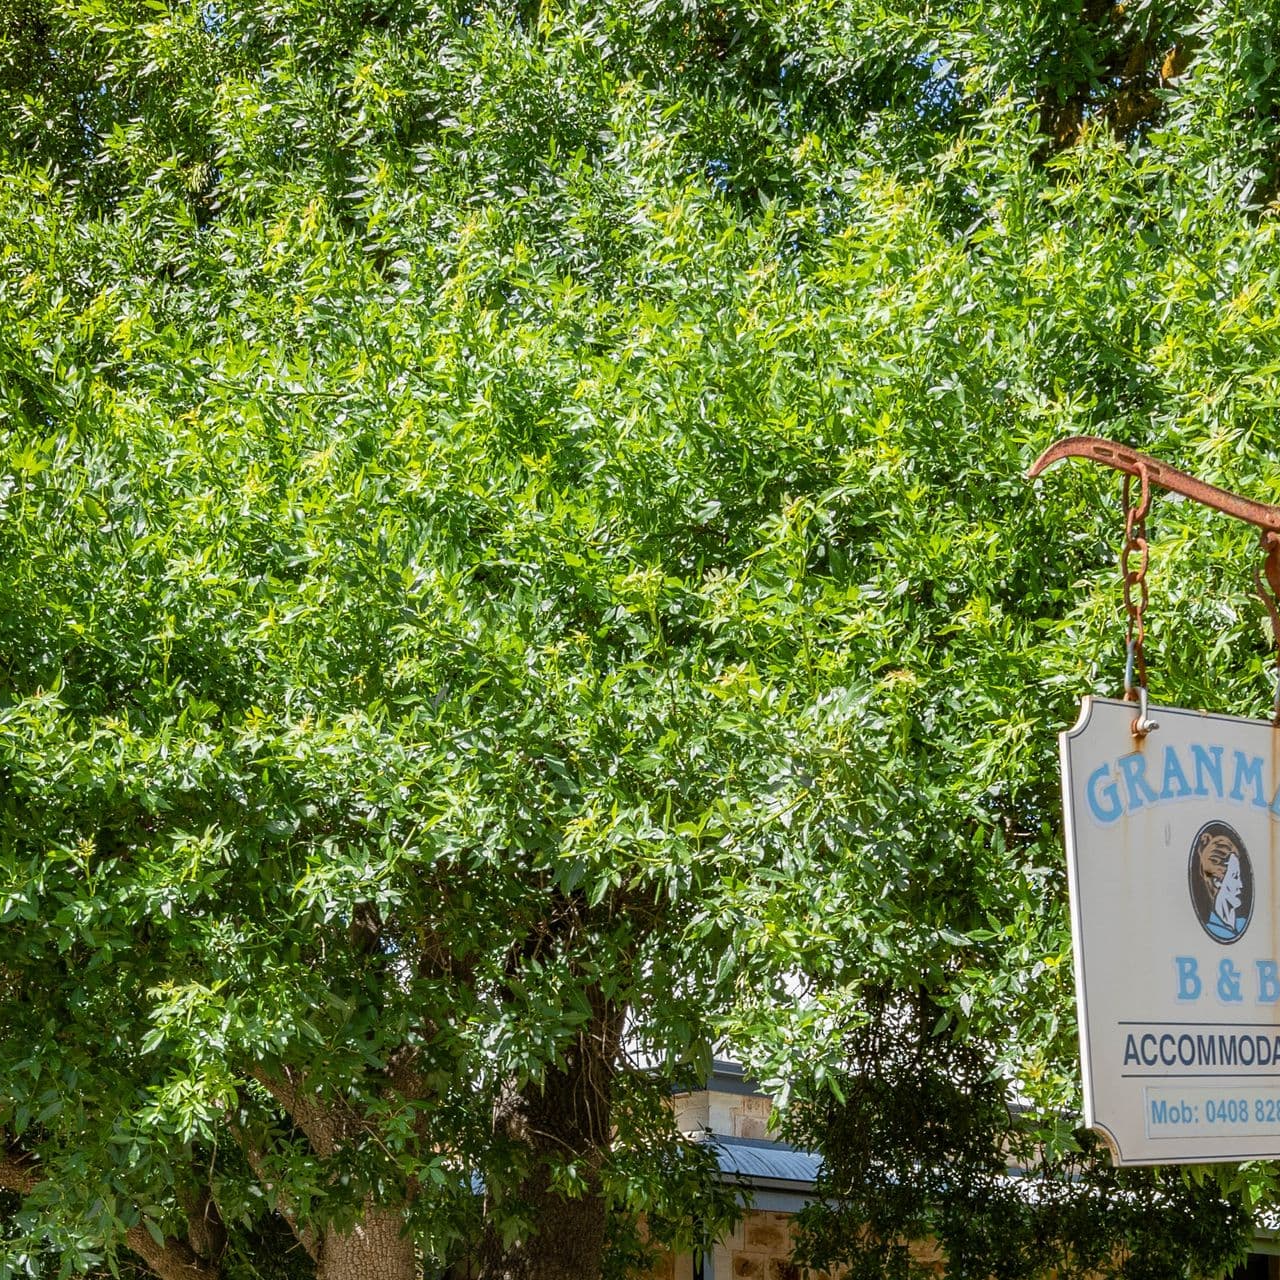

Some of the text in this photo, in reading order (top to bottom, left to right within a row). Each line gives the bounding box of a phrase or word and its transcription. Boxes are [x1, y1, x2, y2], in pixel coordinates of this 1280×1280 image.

[1175, 956, 1202, 1001] B
[1216, 958, 1244, 1002] &
[1151, 1099, 1200, 1125] Mob:
[1206, 1099, 1249, 1123] 0408
